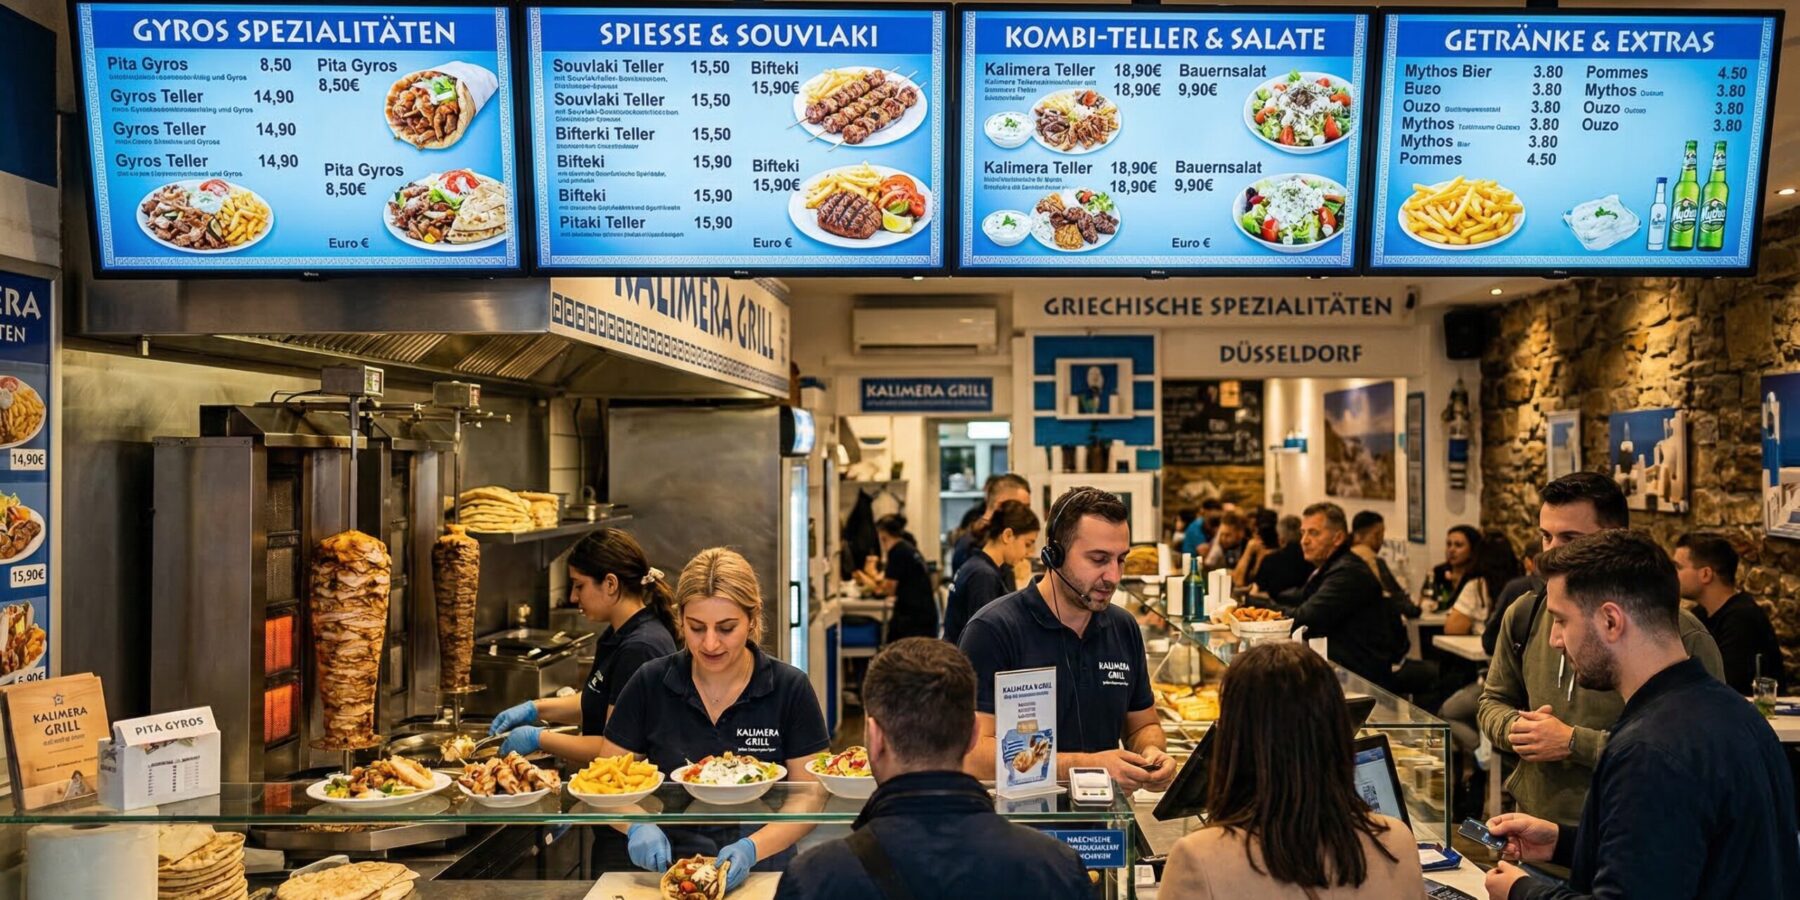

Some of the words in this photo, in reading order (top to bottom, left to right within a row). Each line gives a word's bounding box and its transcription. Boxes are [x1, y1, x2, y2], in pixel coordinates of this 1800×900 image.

[133, 19, 229, 42] GYROS
[237, 15, 455, 44] SPEZIALITÄTEN
[600, 22, 701, 46] SPIESSE
[710, 27, 729, 46] &
[736, 24, 877, 47] SOUVLAKI
[1006, 26, 1199, 49] KOMBI-TELLER
[1205, 29, 1223, 49] &
[1231, 28, 1325, 50] SALATE
[1445, 24, 1585, 52] GETRÄNKE
[1592, 31, 1610, 52] &
[1617, 30, 1714, 53] EXTRAS
[107, 56, 137, 70] Pita
[141, 56, 188, 74] Gyros
[260, 57, 291, 72] 8,50
[317, 58, 347, 72] Pita
[351, 58, 397, 76] Gyros
[553, 58, 618, 73] Souvlaki
[622, 59, 664, 73] Teller
[691, 60, 730, 76] 15,50
[751, 61, 798, 75] Bifteki
[985, 62, 1050, 76] Kalimera
[1054, 63, 1095, 76] Teller
[1114, 63, 1162, 79] 18,90€
[1180, 64, 1266, 77] Bauernsalat
[1405, 63, 1458, 80] Mythos
[1462, 64, 1492, 78] Bier
[1533, 65, 1563, 78] 3.80
[1586, 65, 1648, 79] Pommes
[1718, 66, 1747, 80] 4.50
[226, 73, 247, 82] Gyros
[319, 78, 360, 93] 8,50€
[752, 81, 799, 96] 15,90€
[1114, 83, 1161, 98] 18,90€
[1178, 83, 1217, 98] 9,90€
[1532, 82, 1562, 96] 3.80
[1585, 83, 1637, 100] Mythos
[1717, 84, 1746, 97] 3.80
[110, 88, 156, 106] Gyros
[160, 89, 203, 103] Teller
[254, 89, 294, 105] 14,90
[554, 92, 619, 106] Souvlaki
[623, 92, 665, 106] Teller
[692, 93, 730, 109] 15,50
[1403, 99, 1441, 113] Ouzo
[1531, 100, 1561, 114] 3.80
[1583, 100, 1620, 114] Ouzo
[1715, 102, 1744, 115] 3.80
[113, 121, 159, 139] Gyros
[163, 121, 206, 136] Teller
[256, 122, 296, 138] 14,90
[1402, 116, 1454, 133] Mythos
[1530, 117, 1559, 131] 3.80
[1582, 118, 1619, 131] Ouzo
[1713, 119, 1742, 132] 3.80
[555, 126, 609, 140] Bifterki
[614, 127, 655, 140] Teller
[692, 127, 731, 143] 15,50
[1401, 134, 1453, 151] Mythos
[1528, 135, 1558, 148] 3.80
[115, 153, 162, 170] Gyros
[165, 154, 208, 167] Teller
[259, 154, 298, 170] 14,90
[557, 155, 604, 168] Bifteki
[693, 155, 732, 170] 15,90
[753, 159, 799, 172] Bifteki
[1399, 151, 1462, 165] Pommes
[1527, 153, 1556, 166] 4.50
[324, 163, 353, 176] Pita
[358, 163, 404, 180] Gyros
[984, 161, 1048, 174] Kalimera
[1053, 161, 1093, 174] Teller
[1111, 161, 1157, 176] 18,90€
[1176, 160, 1262, 174] Bauernsalat
[326, 182, 367, 198] 8,50€
[753, 178, 800, 193] 15,90€
[1110, 180, 1157, 195] 18,90€
[1175, 178, 1213, 193] 9,90€
[559, 188, 606, 202] Bifteki
[694, 189, 732, 204] 15,90
[560, 216, 600, 229] Pitaki
[605, 216, 646, 229] Teller
[694, 216, 732, 231] 15,90
[329, 238, 358, 248] Euro
[360, 237, 369, 248] €
[753, 237, 782, 248] Euro
[784, 237, 792, 248] €
[1172, 237, 1200, 248] Euro
[1203, 237, 1210, 248] €
[0, 287, 41, 320] RA
[1044, 297, 1203, 316] GRIECHISCHE
[1211, 296, 1392, 316] SPEZIALITÄTEN
[737, 294, 774, 360] GRILL
[1220, 344, 1362, 363] DÜSSELDORF
[867, 384, 945, 397] KALIMERA
[947, 384, 988, 397] GRILL
[12, 453, 44, 467] 14,90€
[13, 568, 44, 583] 15,90€
[33, 707, 88, 724] KALIMERA
[45, 720, 81, 736] GRILL
[135, 724, 163, 736] PITA
[165, 716, 204, 730] GYROS
[736, 728, 779, 736] KALIMERA
[745, 738, 769, 746] GRILL
